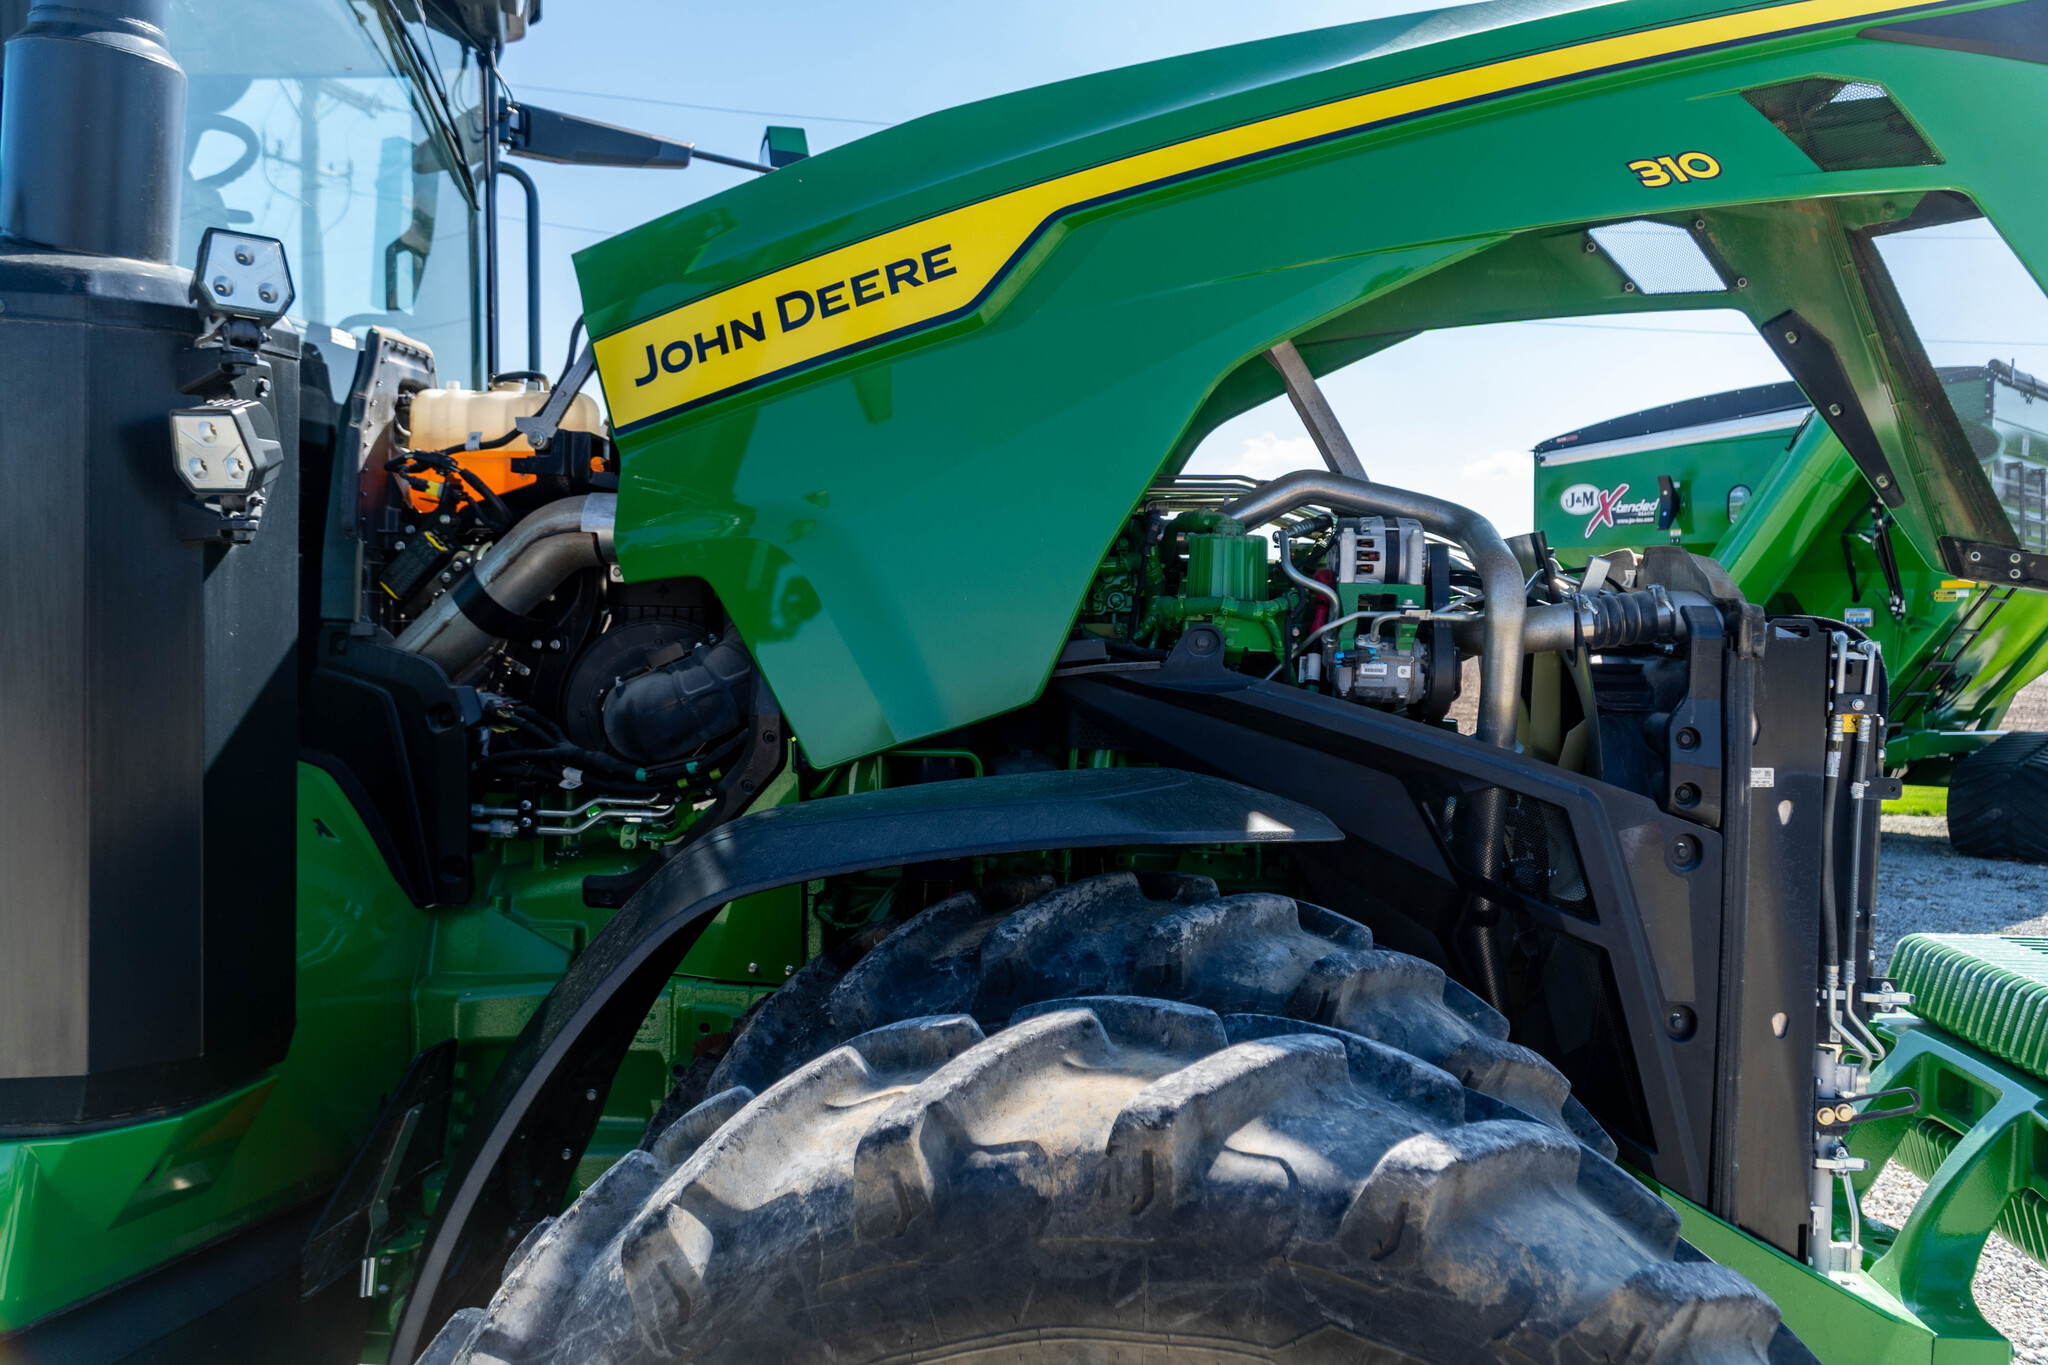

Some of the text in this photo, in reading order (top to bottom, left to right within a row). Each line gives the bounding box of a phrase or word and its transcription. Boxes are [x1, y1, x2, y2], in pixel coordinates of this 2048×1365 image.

[1625, 150, 1722, 188] 310
[635, 244, 957, 387] JOHN DEERE
[1565, 491, 1595, 508] J&M
